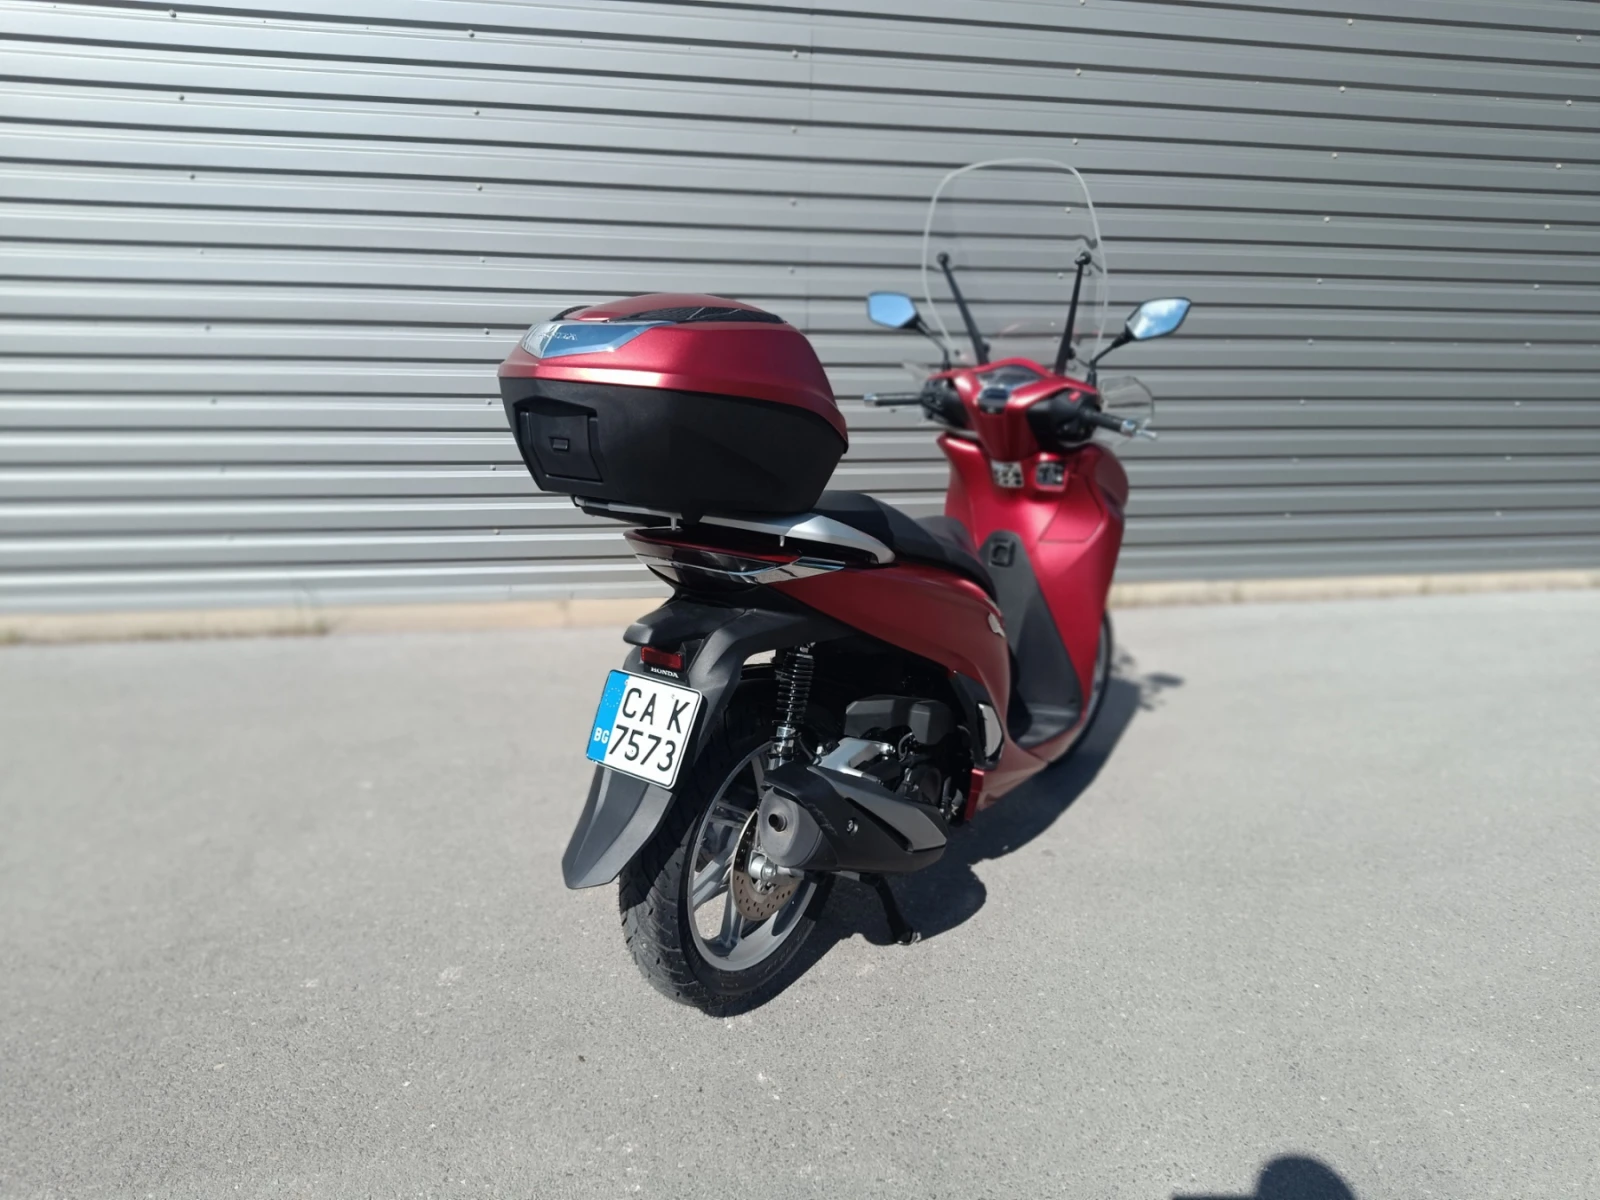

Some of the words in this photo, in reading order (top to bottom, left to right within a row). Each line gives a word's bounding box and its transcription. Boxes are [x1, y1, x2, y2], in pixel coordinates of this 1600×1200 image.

[651, 666, 679, 679] HONDA
[622, 687, 657, 726] CA
[666, 699, 691, 734] K
[593, 727, 610, 744] BG
[608, 723, 676, 772] 7573
